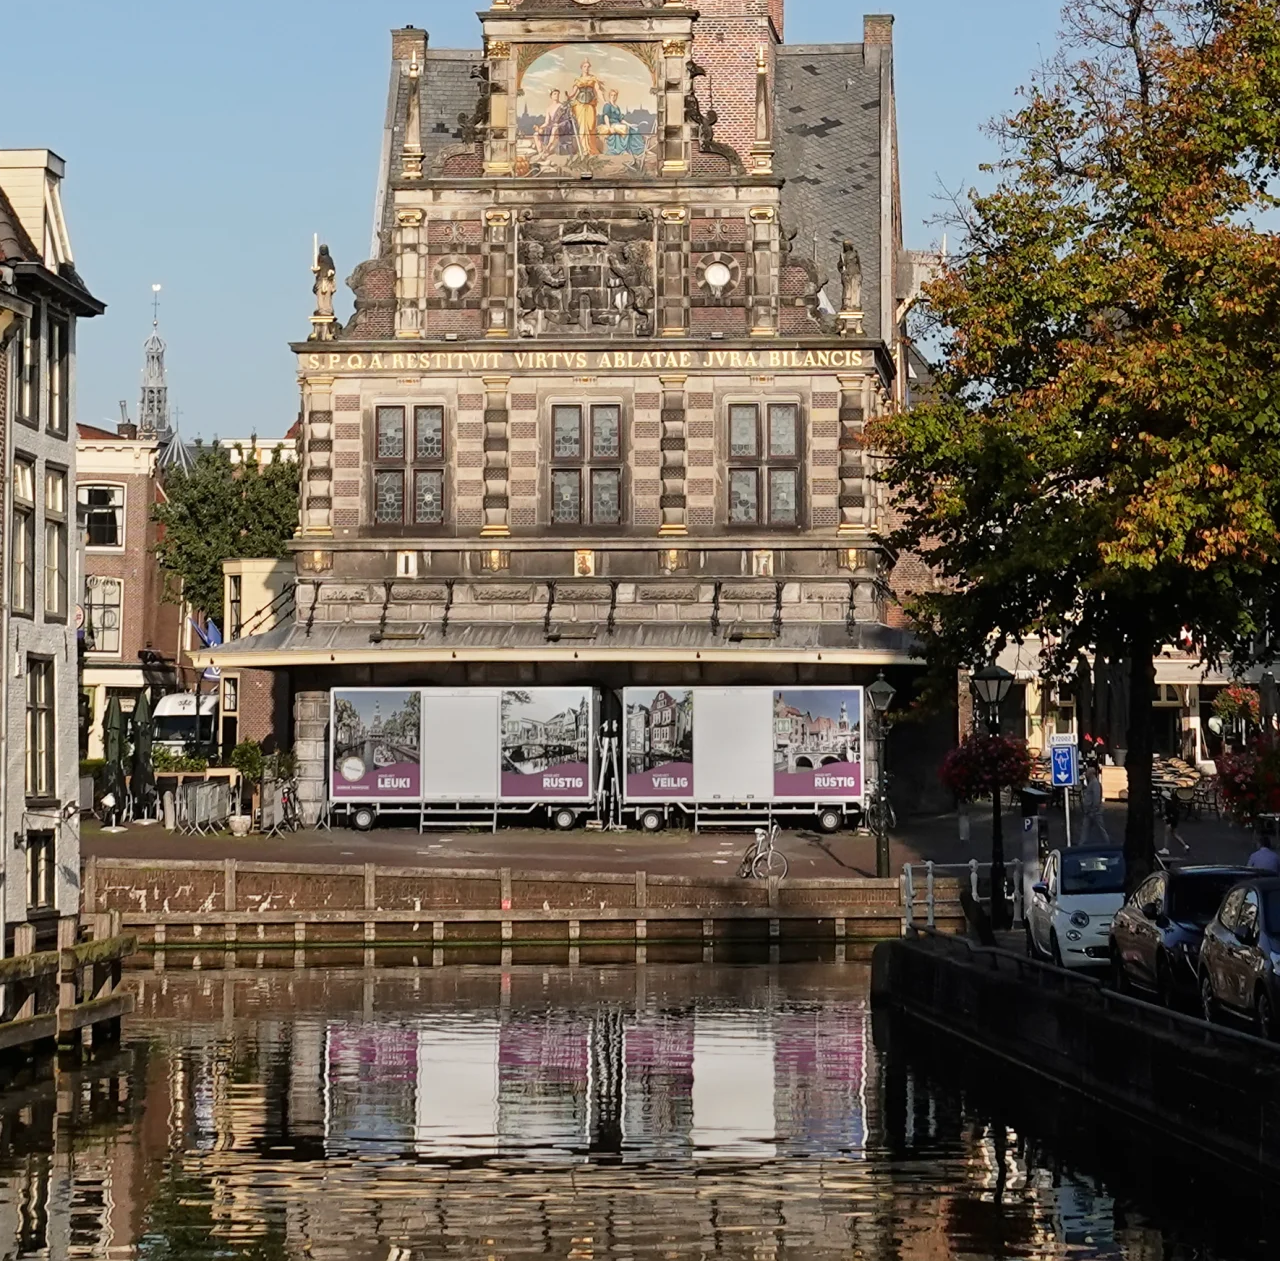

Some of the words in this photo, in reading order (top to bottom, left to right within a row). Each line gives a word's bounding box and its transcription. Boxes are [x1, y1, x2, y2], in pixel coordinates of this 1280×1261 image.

[514, 351, 587, 369] VIRTVS
[599, 351, 692, 368] ABLATAE
[703, 350, 757, 368] JVRA
[769, 350, 863, 367] BILANCIS
[542, 777, 583, 788] RUSTIG
[652, 777, 688, 788] VEILIG
[814, 776, 855, 788] RUSTIG
[1024, 818, 1032, 830] P
